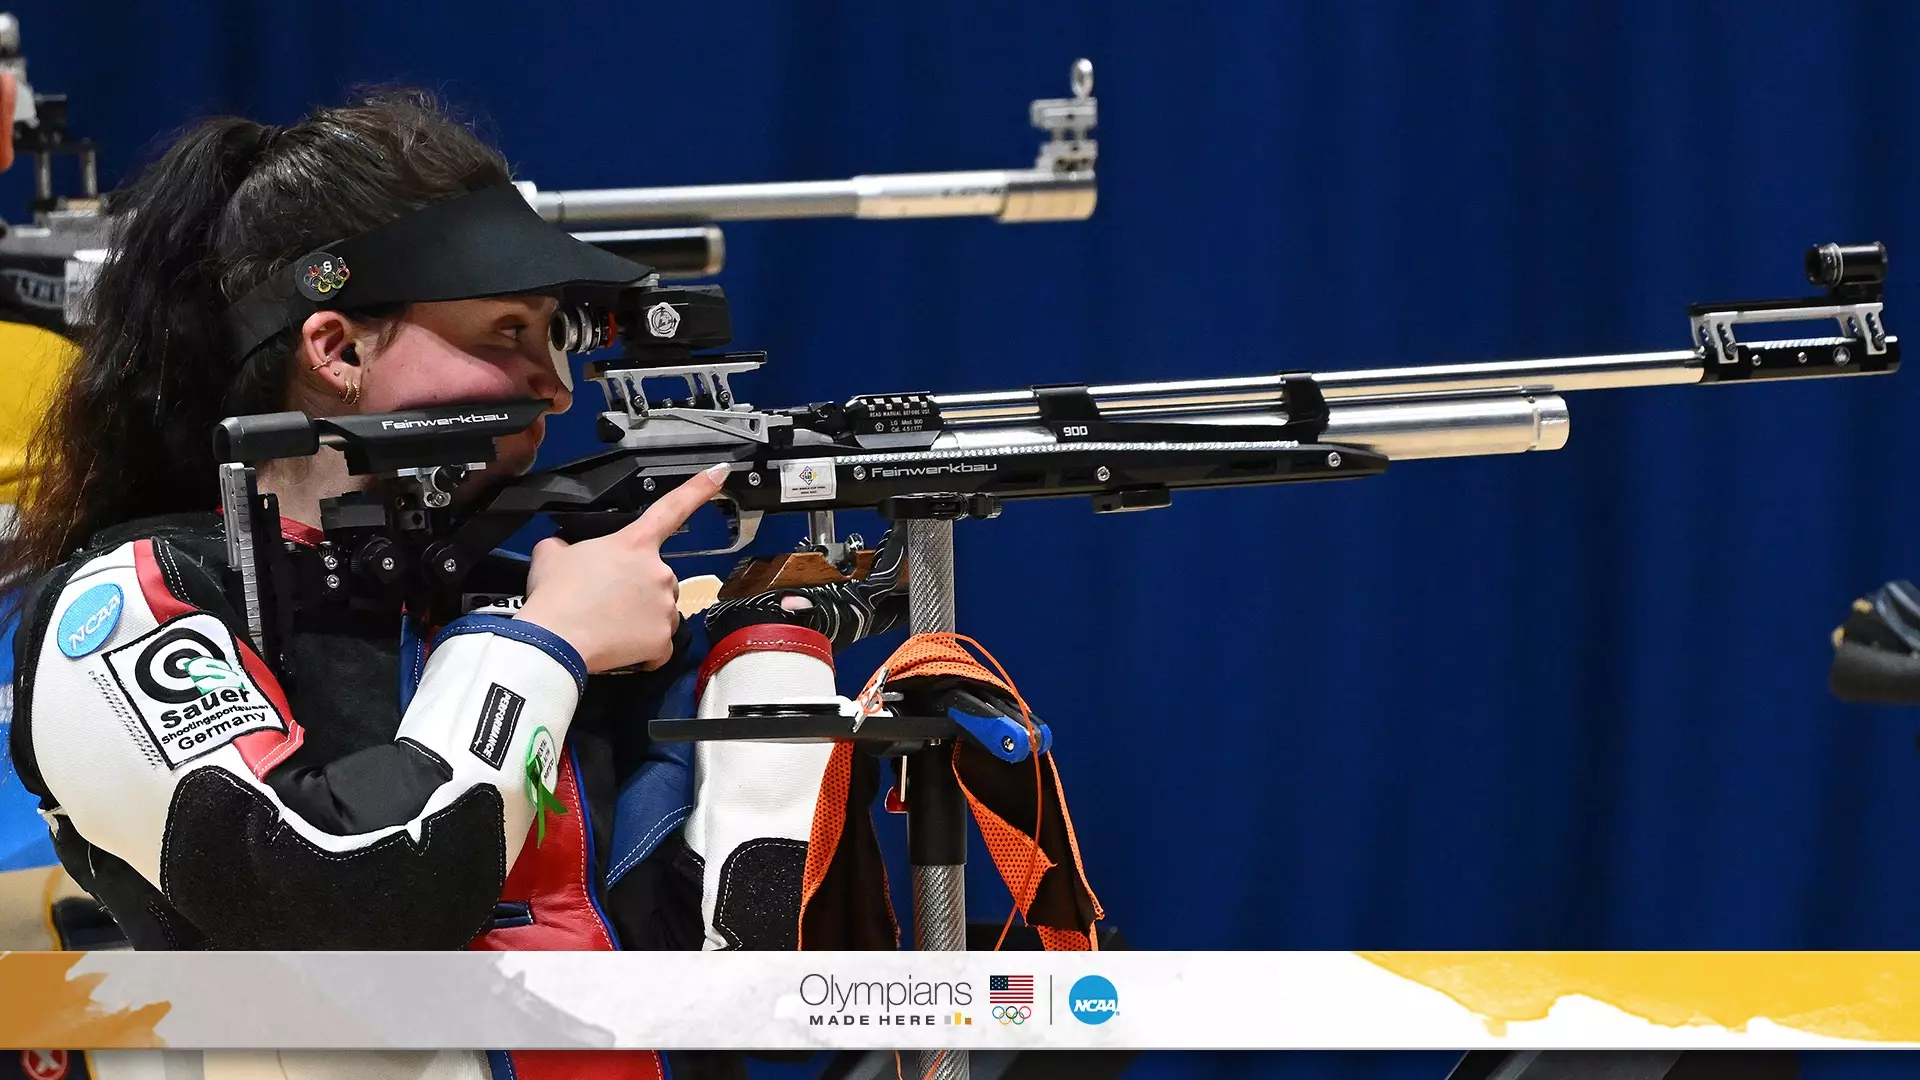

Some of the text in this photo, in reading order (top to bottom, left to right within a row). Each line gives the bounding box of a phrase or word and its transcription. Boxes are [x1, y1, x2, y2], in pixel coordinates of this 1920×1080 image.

[381, 412, 509, 430] Feinwerkbau
[1063, 426, 1089, 438] 900
[871, 461, 998, 479] Feinwerkbau
[68, 593, 121, 650] NCAA
[160, 688, 251, 730] Sauer
[483, 691, 512, 759] PERFORMANCE
[178, 711, 266, 751] Germany
